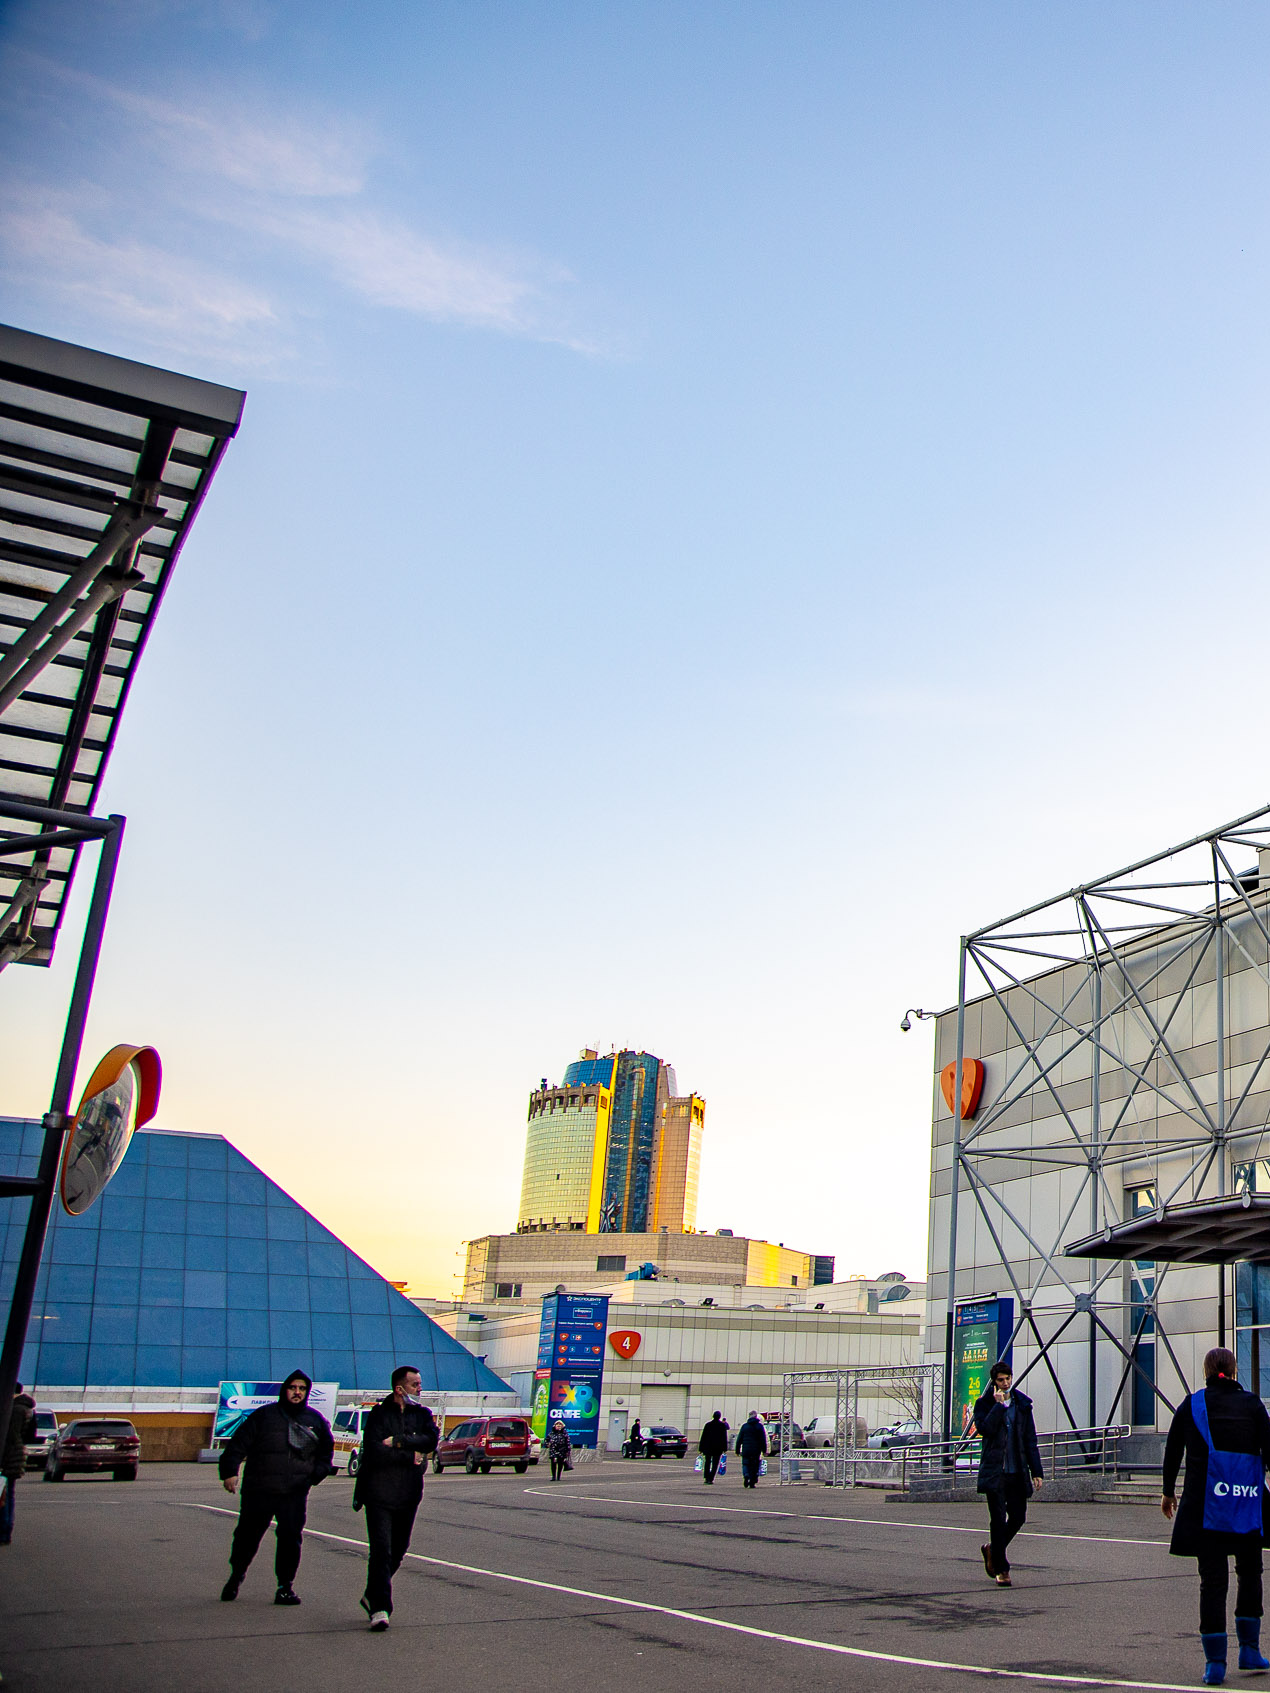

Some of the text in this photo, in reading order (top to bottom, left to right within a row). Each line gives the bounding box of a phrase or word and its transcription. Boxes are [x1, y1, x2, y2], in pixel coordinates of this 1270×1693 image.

[622, 1336, 631, 1350] 4
[969, 1376, 980, 1389] 2-6
[1233, 1484, 1258, 1498] BYK
